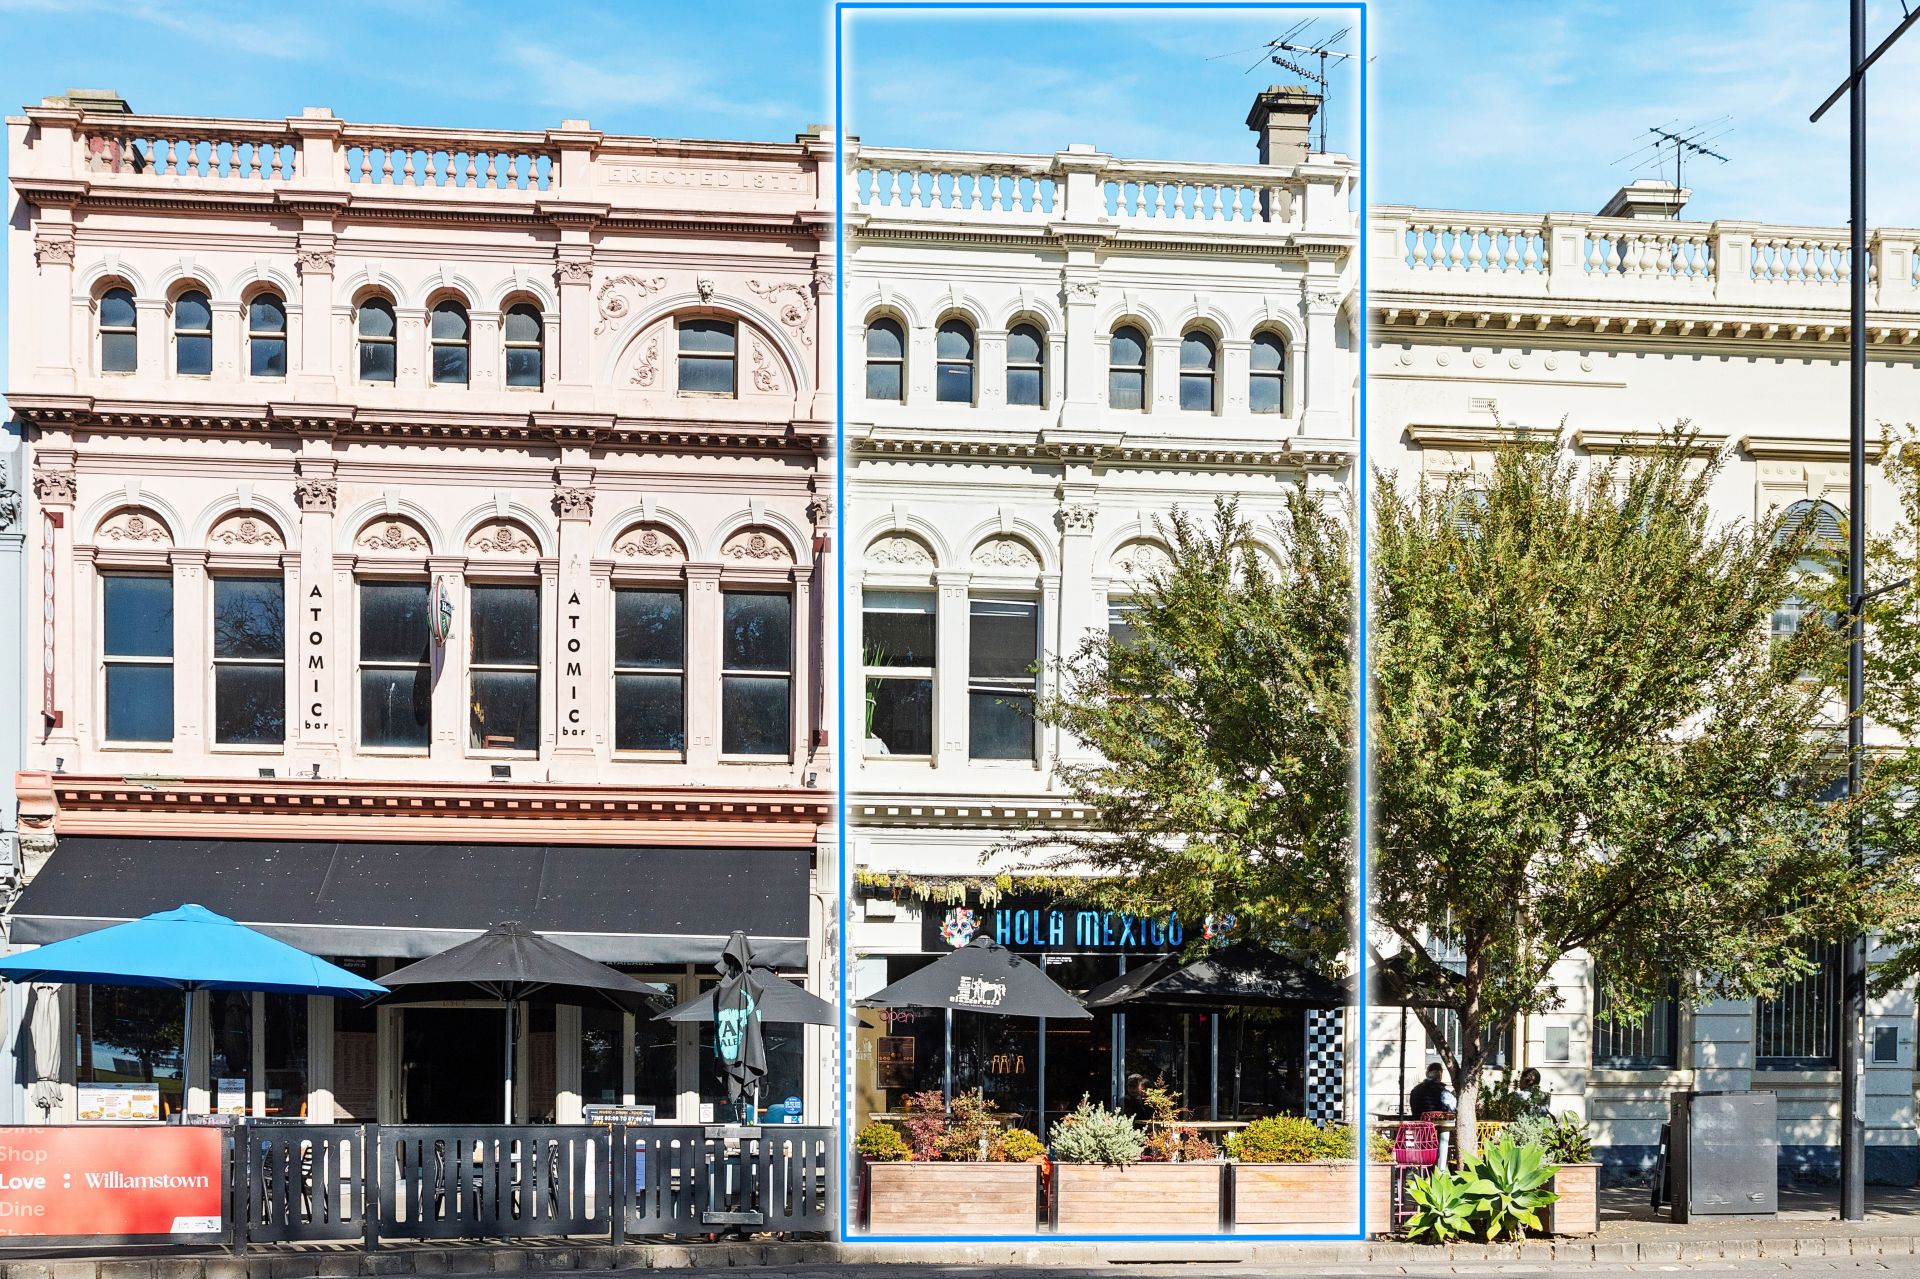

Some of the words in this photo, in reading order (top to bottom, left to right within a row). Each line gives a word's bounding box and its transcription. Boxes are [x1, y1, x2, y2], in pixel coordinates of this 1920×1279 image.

[608, 169, 731, 187] ERECTED
[309, 584, 324, 717] ATOMIC
[566, 592, 582, 723] ATOMIC
[305, 720, 329, 730] bar
[562, 726, 586, 736] bar
[995, 909, 1065, 946] HOLA
[0, 1146, 48, 1164] Shop
[0, 1173, 46, 1189] Love
[85, 1171, 209, 1189] Williamstown
[0, 1202, 45, 1216] Dine
